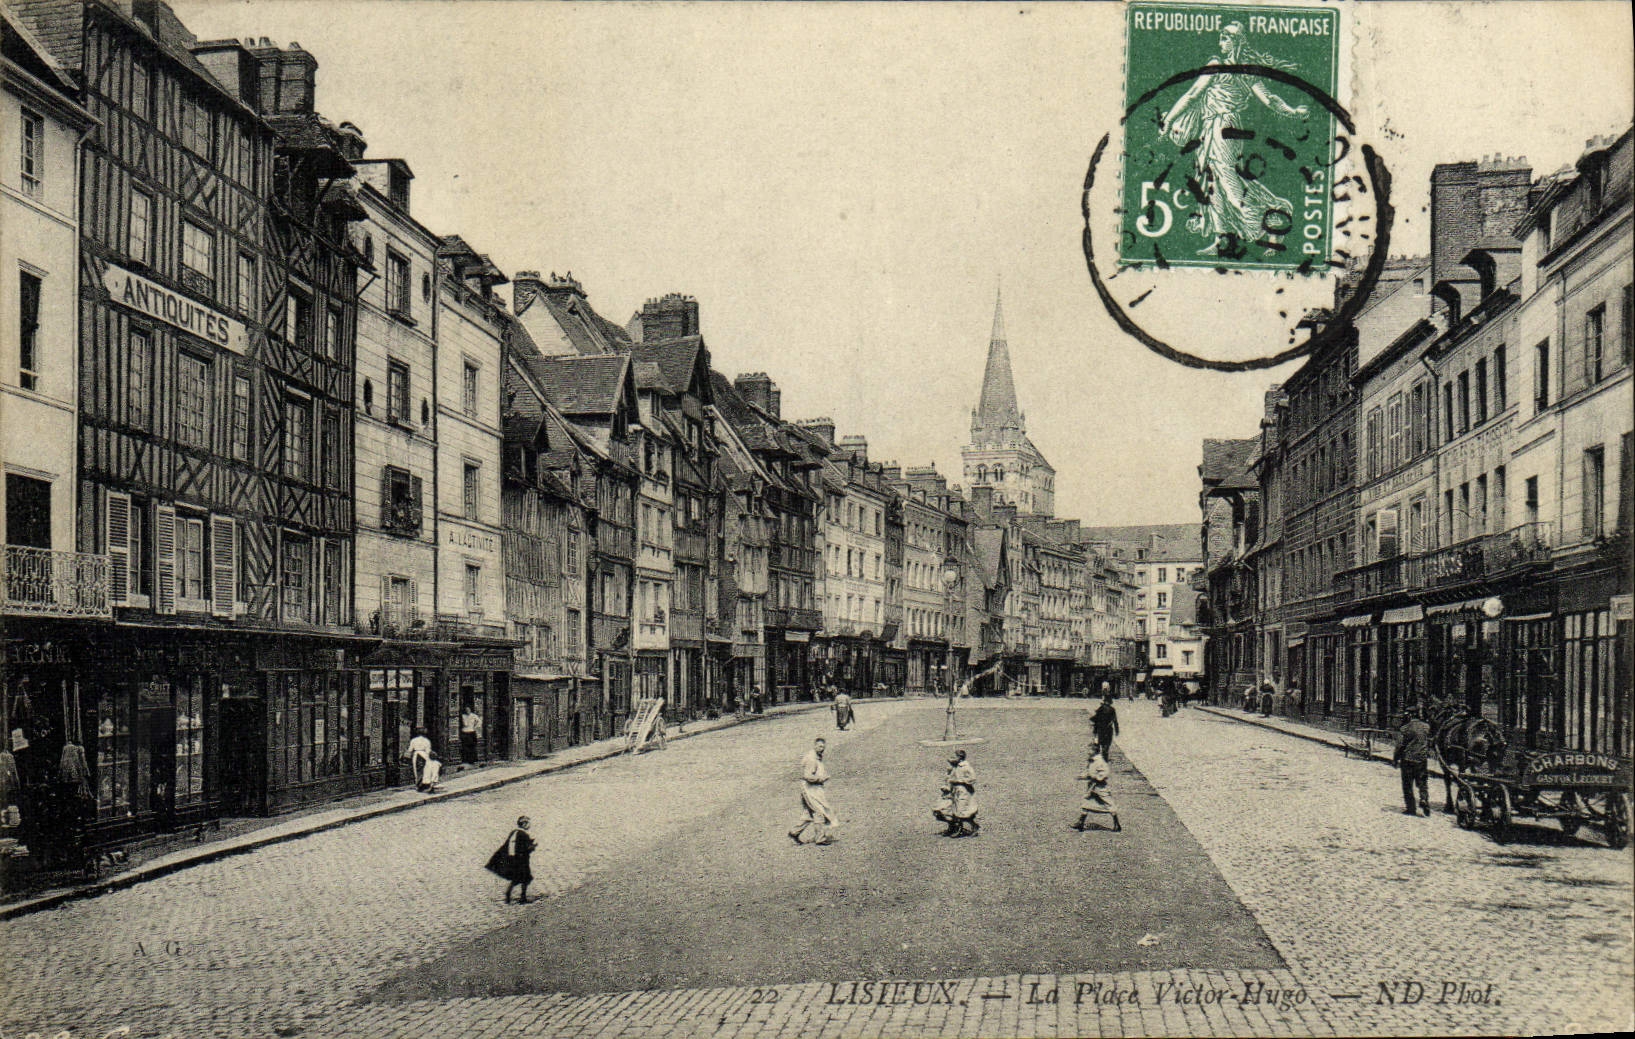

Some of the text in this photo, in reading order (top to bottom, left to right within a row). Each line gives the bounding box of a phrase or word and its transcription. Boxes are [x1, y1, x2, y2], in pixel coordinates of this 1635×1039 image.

[1249, 16, 1330, 37] FRANÇAISE
[1303, 170, 1325, 255] POSTES
[123, 275, 229, 346] ANTIQUITÉS
[1531, 754, 1618, 772] CHARBONS
